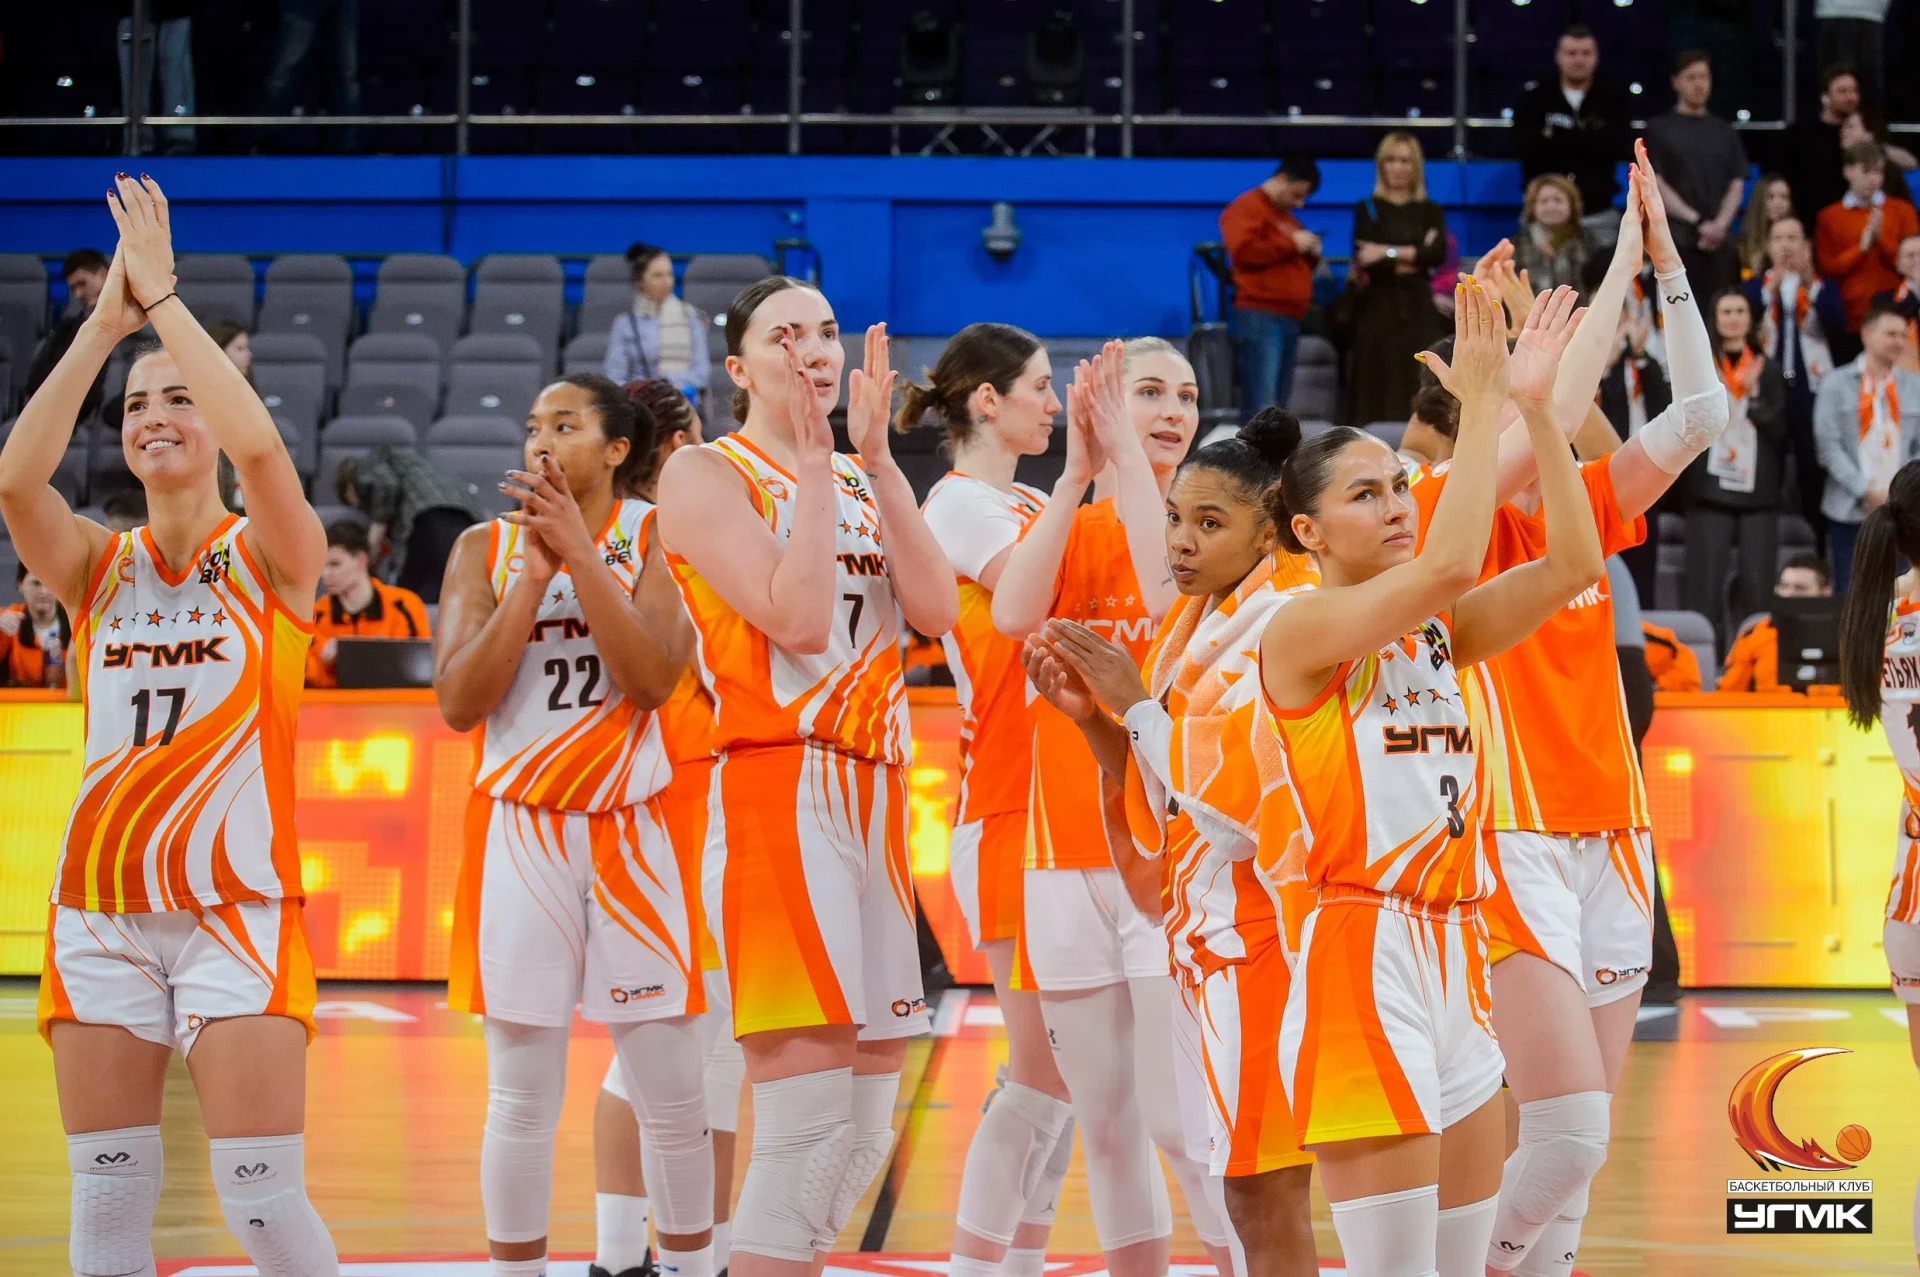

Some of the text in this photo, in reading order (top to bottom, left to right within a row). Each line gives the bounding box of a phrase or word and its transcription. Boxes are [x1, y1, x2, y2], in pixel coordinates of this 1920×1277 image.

[837, 553, 890, 577] МК
[527, 617, 590, 642] ГМ
[843, 593, 864, 649] 7
[103, 635, 231, 669] УГМК
[544, 654, 603, 711] 22
[131, 687, 186, 747] 17
[1440, 774, 1465, 838] 3
